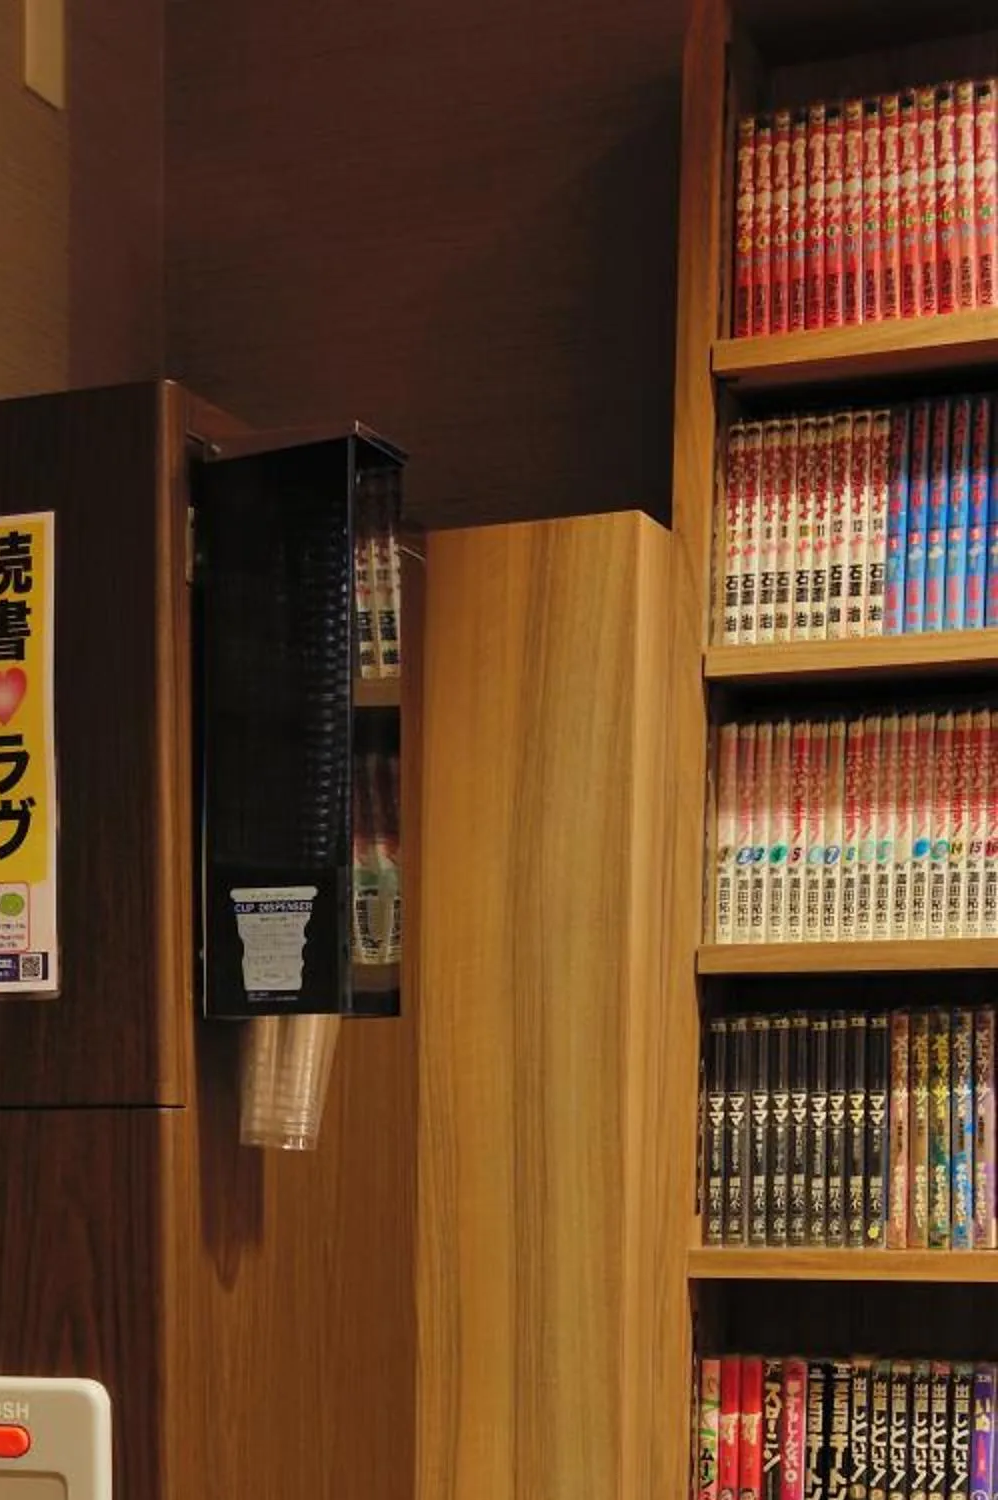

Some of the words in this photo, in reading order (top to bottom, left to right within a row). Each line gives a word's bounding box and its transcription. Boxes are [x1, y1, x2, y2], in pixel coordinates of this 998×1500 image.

[969, 841, 982, 853] 15
[234, 903, 255, 912] CUP
[709, 1096, 724, 1125] ママ
[729, 1096, 745, 1125] ママ
[753, 1095, 768, 1124] ママ
[773, 1095, 789, 1124] ママ
[791, 1093, 807, 1122] ママ
[811, 1098, 827, 1127] ママ
[830, 1095, 844, 1124] ママ
[850, 1094, 865, 1124] ママ
[869, 1096, 885, 1124] ママ
